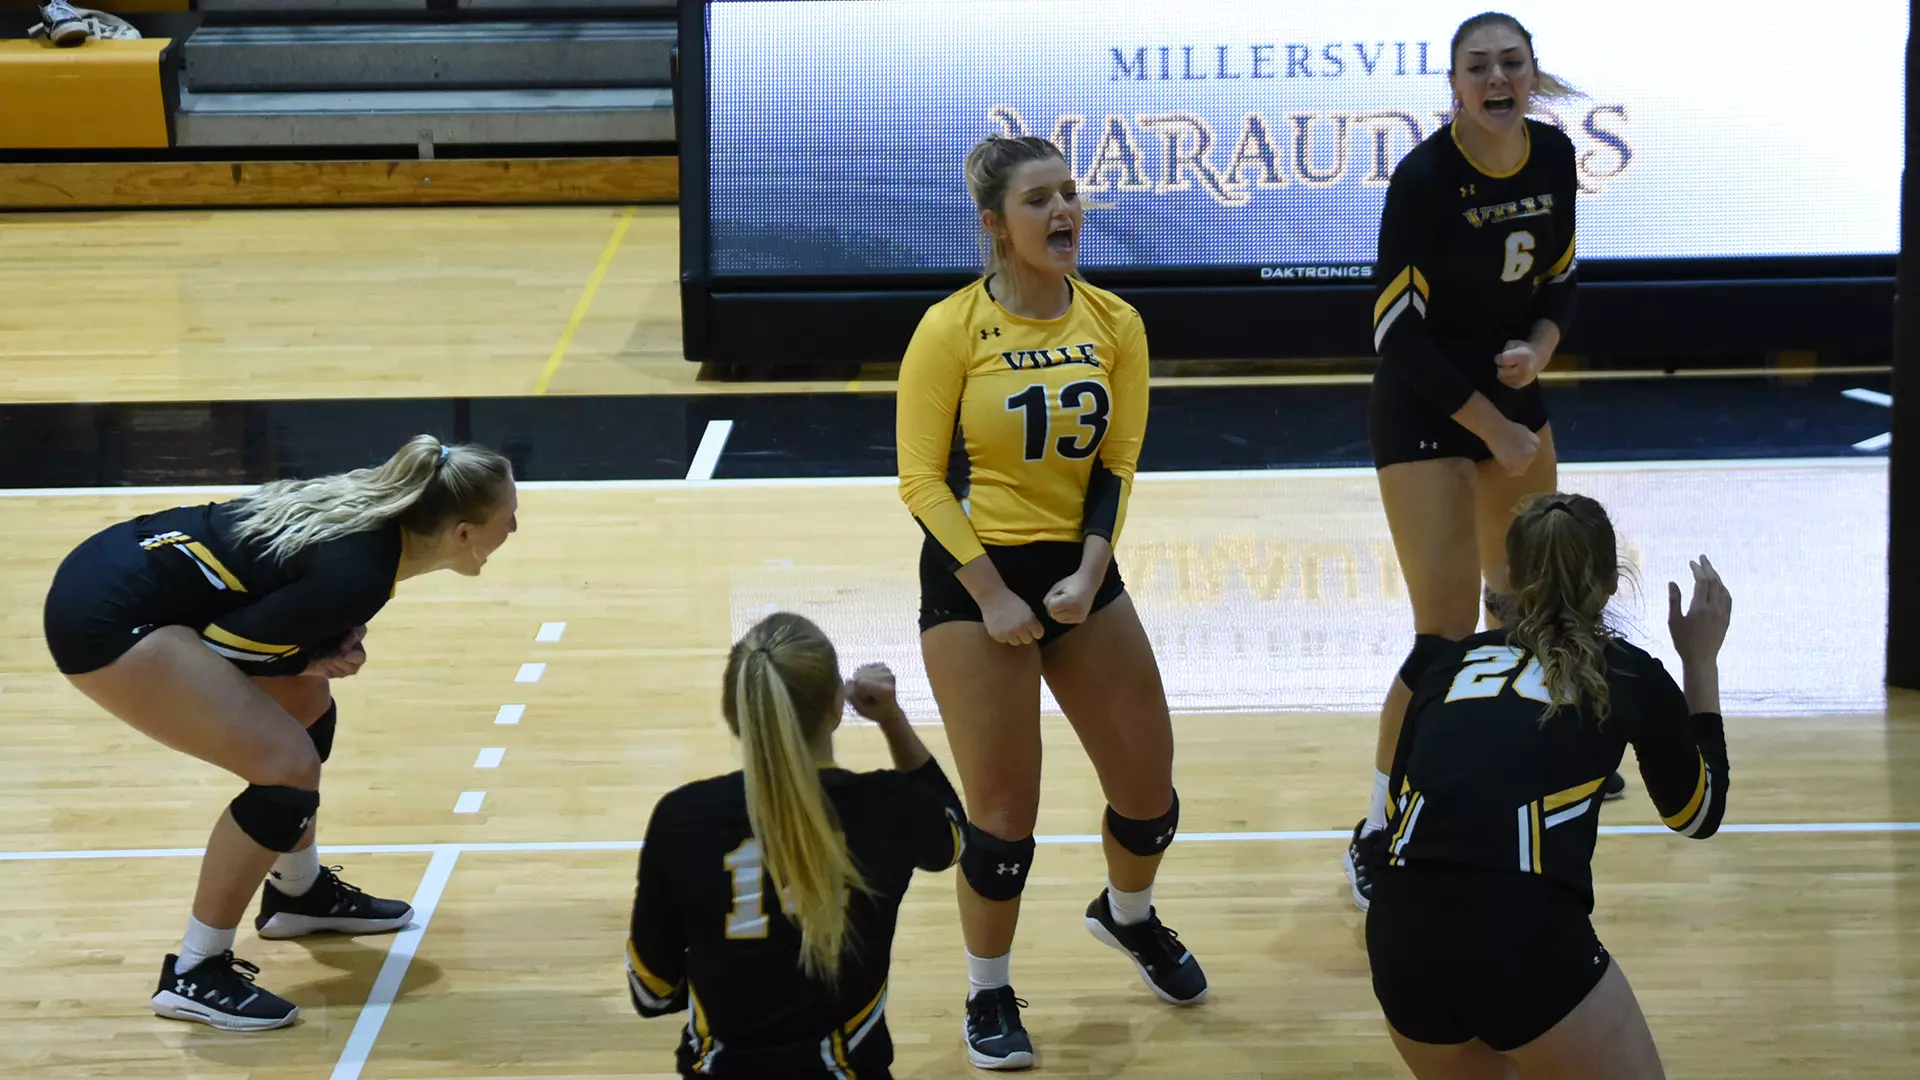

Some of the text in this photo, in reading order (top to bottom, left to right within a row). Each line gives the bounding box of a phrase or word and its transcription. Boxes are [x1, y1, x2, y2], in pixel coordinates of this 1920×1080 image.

[1108, 43, 1450, 80] MILLERSVIL
[988, 104, 1634, 205] ARAUDS
[1260, 265, 1373, 279] DAKTRONICS
[1500, 230, 1535, 282] 6
[1001, 343, 1101, 371] VILLE
[1005, 379, 1113, 462] 13
